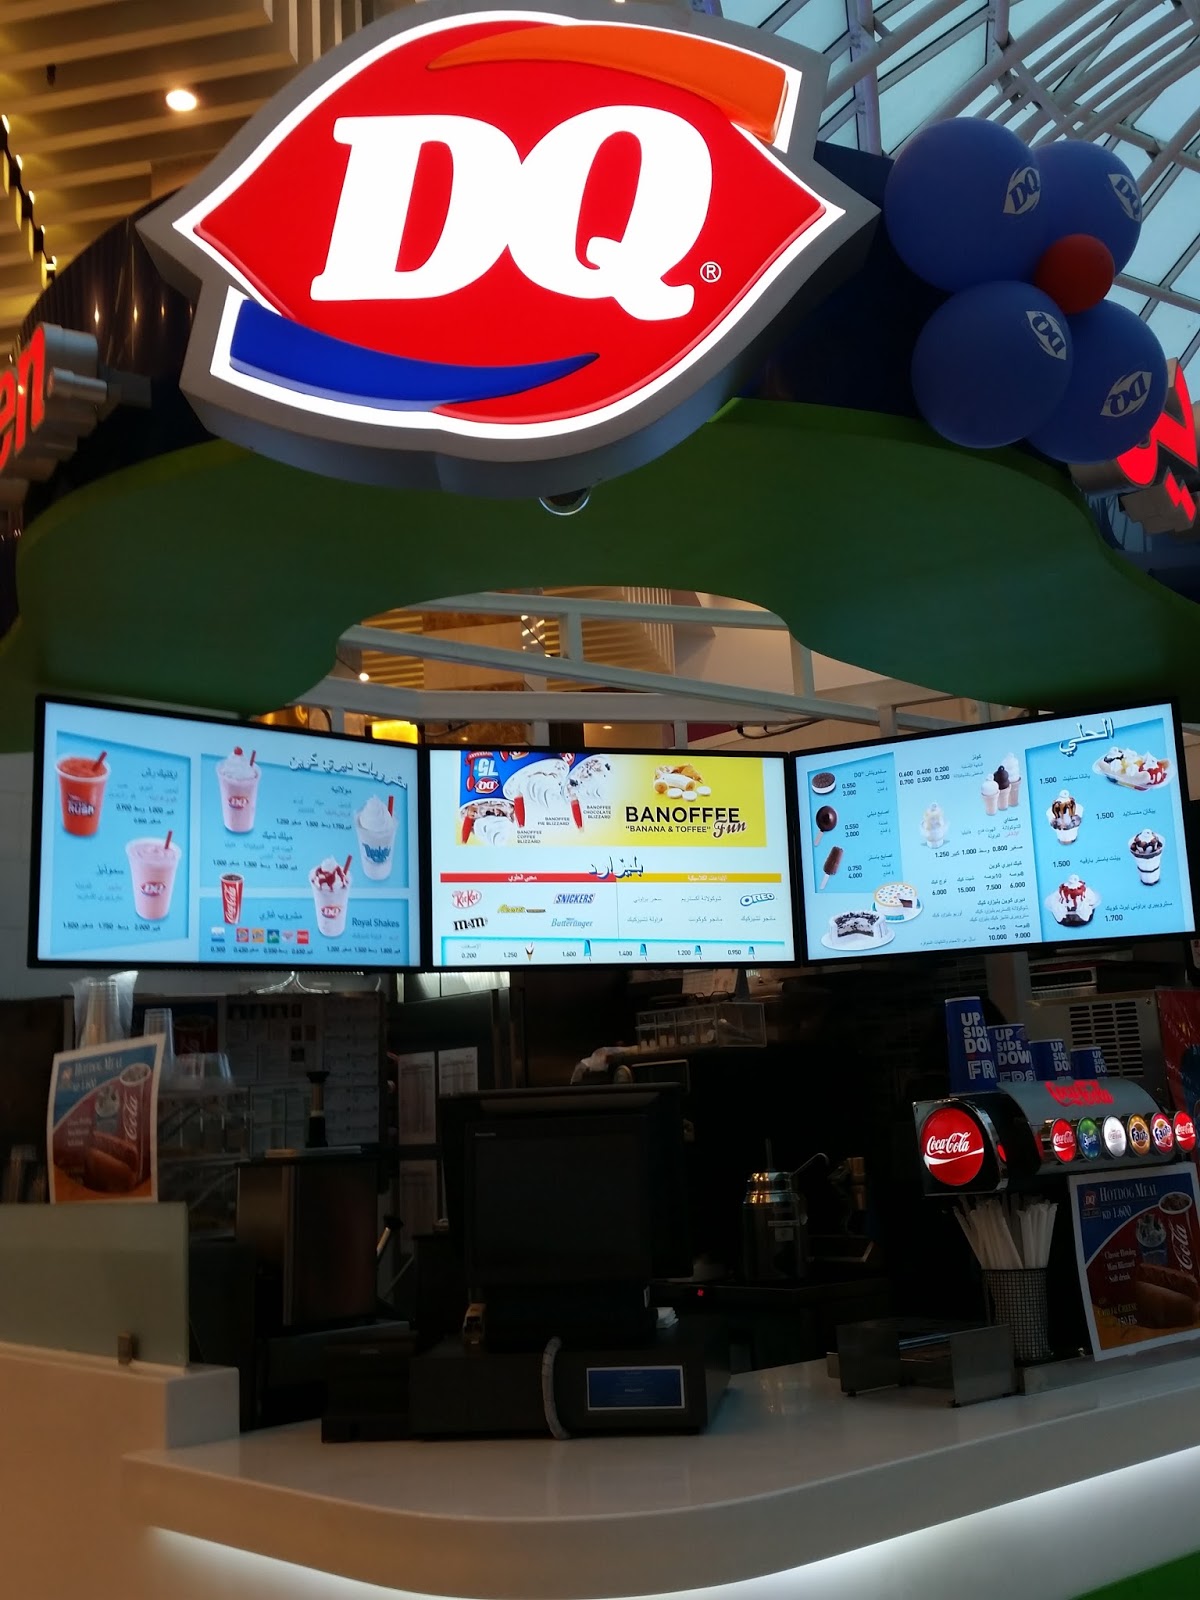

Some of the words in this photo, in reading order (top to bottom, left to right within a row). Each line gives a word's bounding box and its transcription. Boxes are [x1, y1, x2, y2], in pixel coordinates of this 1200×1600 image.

[1008, 169, 1040, 214] DQ
[1115, 174, 1141, 221] DQ
[310, 105, 713, 321] DQ
[1031, 312, 1066, 358] DQ
[1110, 372, 1148, 416] DQ
[478, 759, 499, 777] 75
[358, 762, 407, 790] مشروبات
[480, 781, 494, 790] DQ
[625, 806, 740, 823] BANOFFEE
[1096, 812, 1114, 820] 1.500
[713, 820, 746, 838] Fun
[589, 856, 643, 879] بليزارد
[1053, 860, 1070, 868] 1.500
[457, 890, 478, 907] KitKat
[555, 893, 594, 904] SNICKERS
[740, 892, 775, 907] OREO
[352, 917, 372, 928] Royal
[374, 918, 400, 928] Shakes
[551, 918, 593, 929] Butterfinger
[961, 1012, 981, 1026] UP
[995, 1028, 1014, 1041] UP
[996, 1040, 1023, 1052] SIDE
[1050, 1042, 1064, 1052] UP
[1044, 1080, 1114, 1106] Coca-Cola
[1053, 1131, 1074, 1143] Coca-Cola
[1084, 1133, 1097, 1145] Sprite
[1131, 1128, 1148, 1141] Fanta
[1154, 1125, 1172, 1140] Fanta
[926, 1132, 971, 1154] Coca-Cola
[1085, 1195, 1096, 1205] DQ
[1112, 1206, 1131, 1218] 1.600
